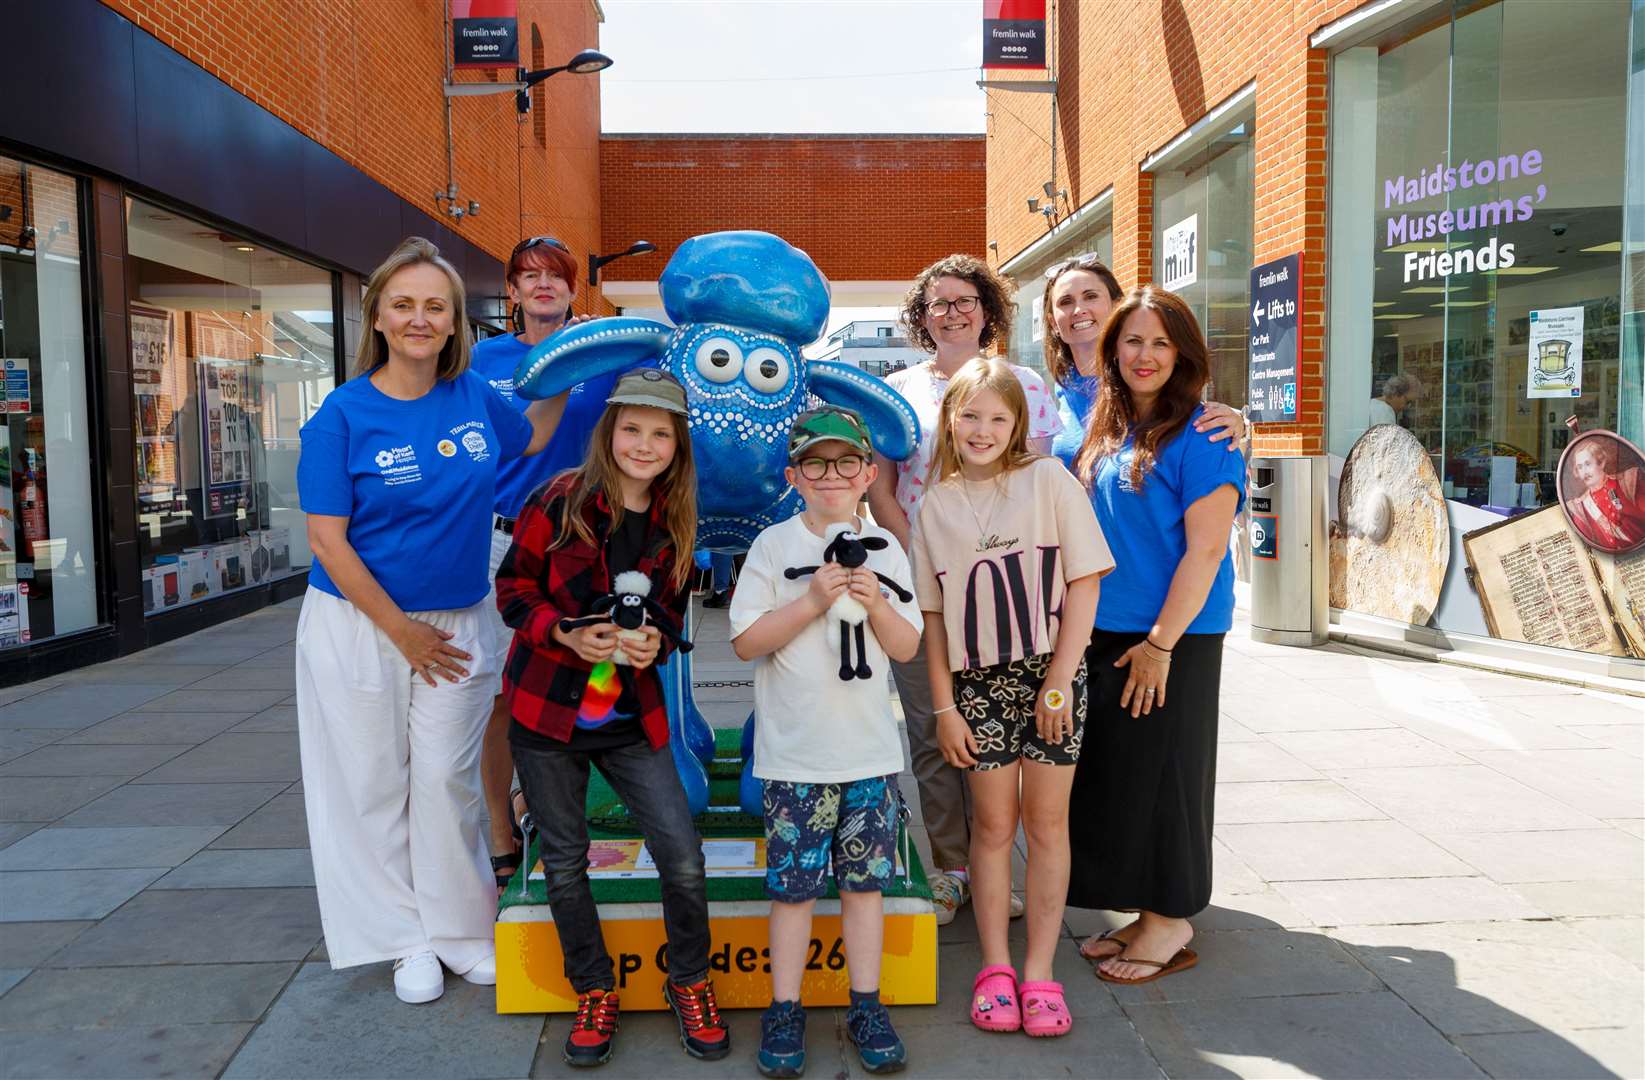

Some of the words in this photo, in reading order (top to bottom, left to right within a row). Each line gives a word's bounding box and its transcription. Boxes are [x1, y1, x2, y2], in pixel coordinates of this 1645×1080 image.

[463, 27, 489, 37] fremlin
[490, 27, 508, 37] walk
[992, 28, 1018, 39] fremlin
[1019, 29, 1036, 39] walk
[1384, 149, 1543, 209] Maidstone
[1403, 237, 1516, 283] Friends
[1259, 273, 1276, 288] fremlin
[1276, 267, 1289, 282] walk
[1267, 299, 1284, 320] Lifts
[1285, 299, 1295, 316] to
[1252, 335, 1260, 346] Car
[1260, 333, 1270, 345] Park
[148, 341, 168, 366] £15
[1252, 351, 1276, 363] Restaurants
[1251, 369, 1265, 380] Centre
[1266, 366, 1294, 379] Management
[221, 383, 238, 399] TOP
[1251, 388, 1264, 399] Public
[223, 402, 237, 423] 100
[1251, 400, 1264, 411] Toilets
[227, 425, 237, 443] TV
[976, 534, 1019, 552] Always
[655, 941, 771, 976] Cde:
